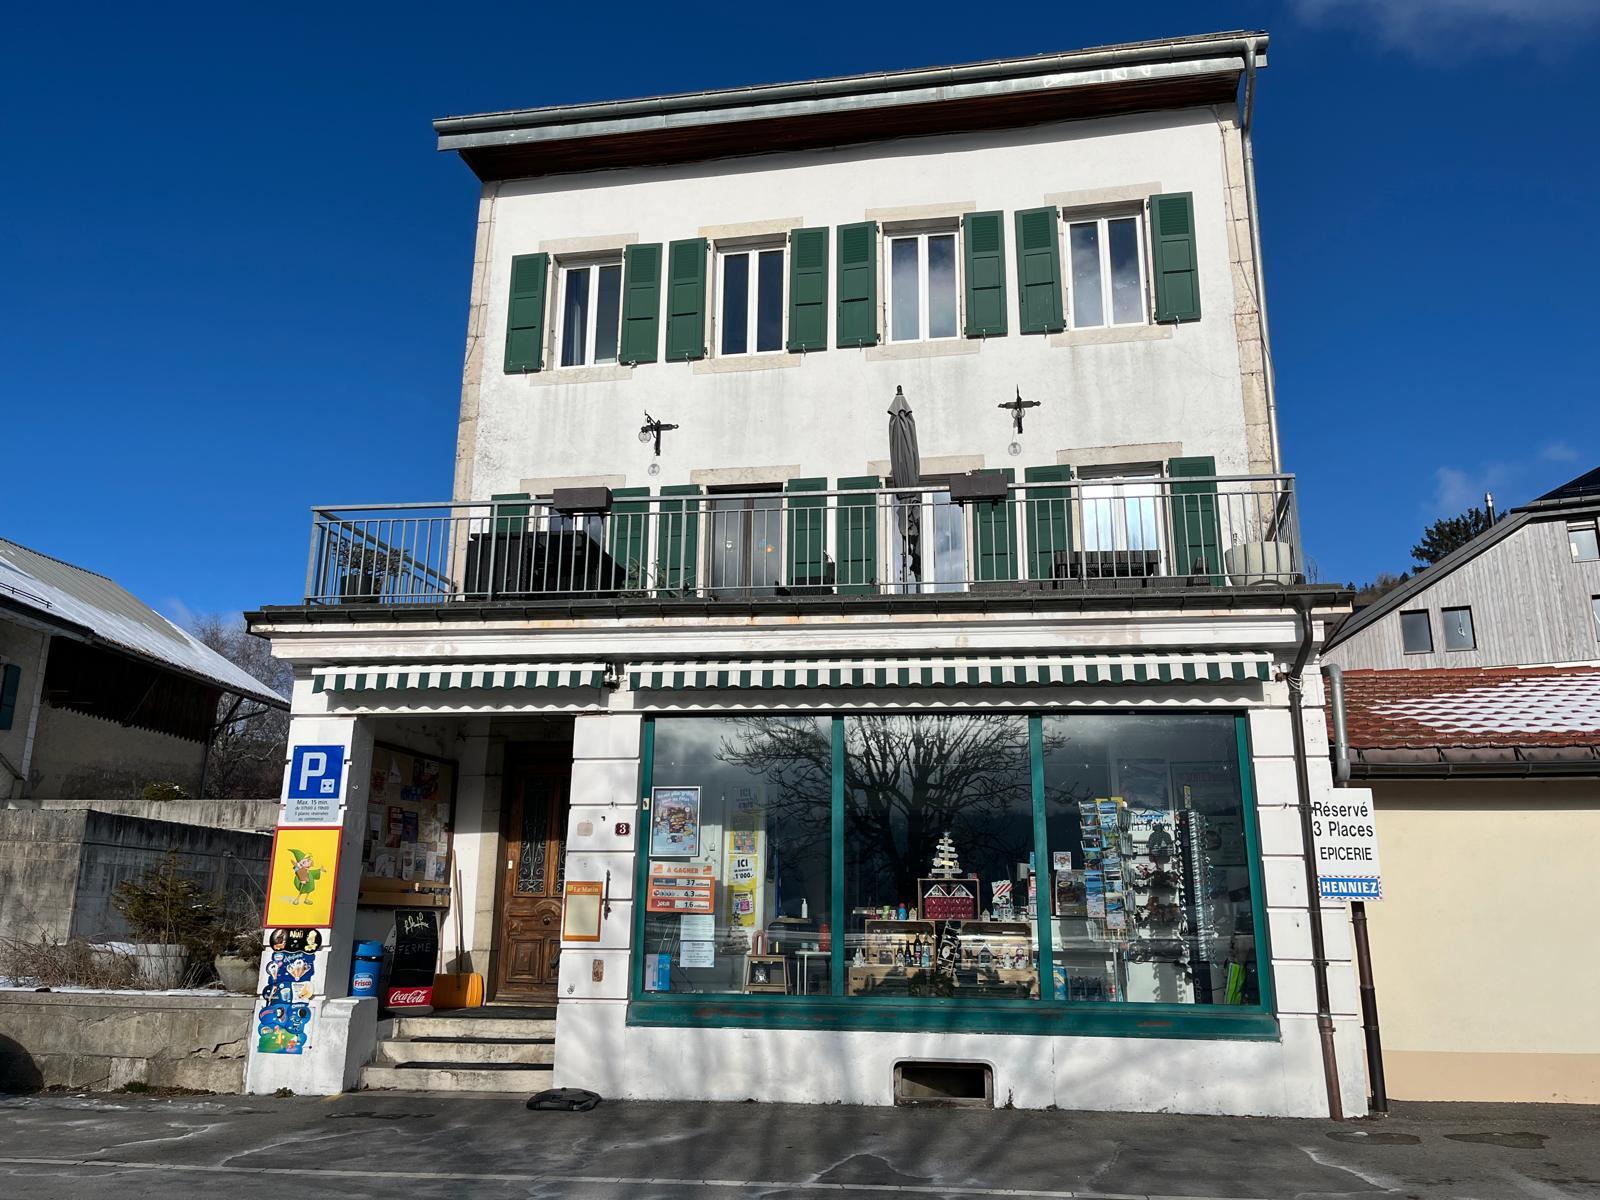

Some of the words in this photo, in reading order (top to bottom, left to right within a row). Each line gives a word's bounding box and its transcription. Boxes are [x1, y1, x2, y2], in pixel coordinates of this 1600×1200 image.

[299, 752, 327, 790] P
[1313, 801, 1368, 817] Réservé
[619, 824, 626, 834] 3
[1313, 821, 1322, 837] 3
[1329, 821, 1373, 837] Places
[1320, 847, 1373, 860] EPICERIE
[737, 859, 748, 867] ICI
[1321, 881, 1379, 893] HENNIEZ
[354, 979, 371, 987] Frisco
